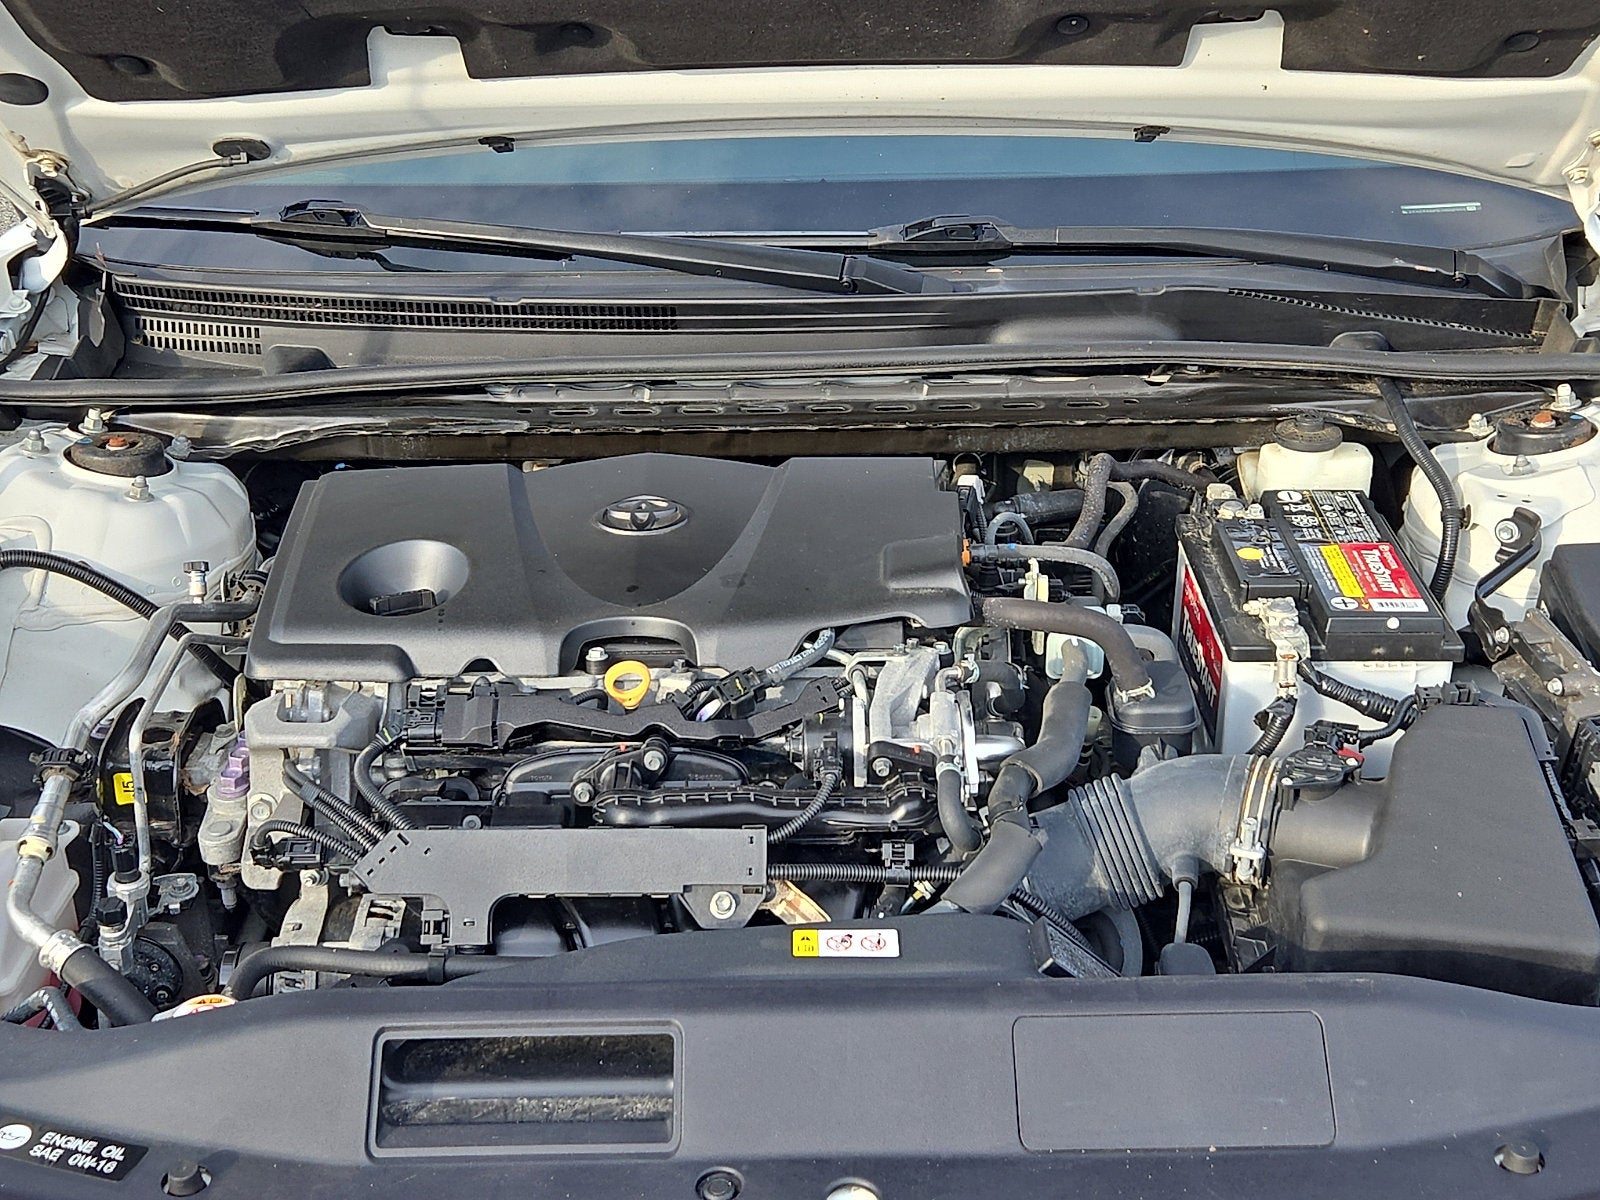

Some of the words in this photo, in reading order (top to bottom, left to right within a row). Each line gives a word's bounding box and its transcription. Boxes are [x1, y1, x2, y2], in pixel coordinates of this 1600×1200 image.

[29, 1144, 65, 1162] SAE
[67, 1153, 118, 1174] 0W-16
[40, 1132, 98, 1154] ENGINE
[101, 1145, 126, 1161] OIL
